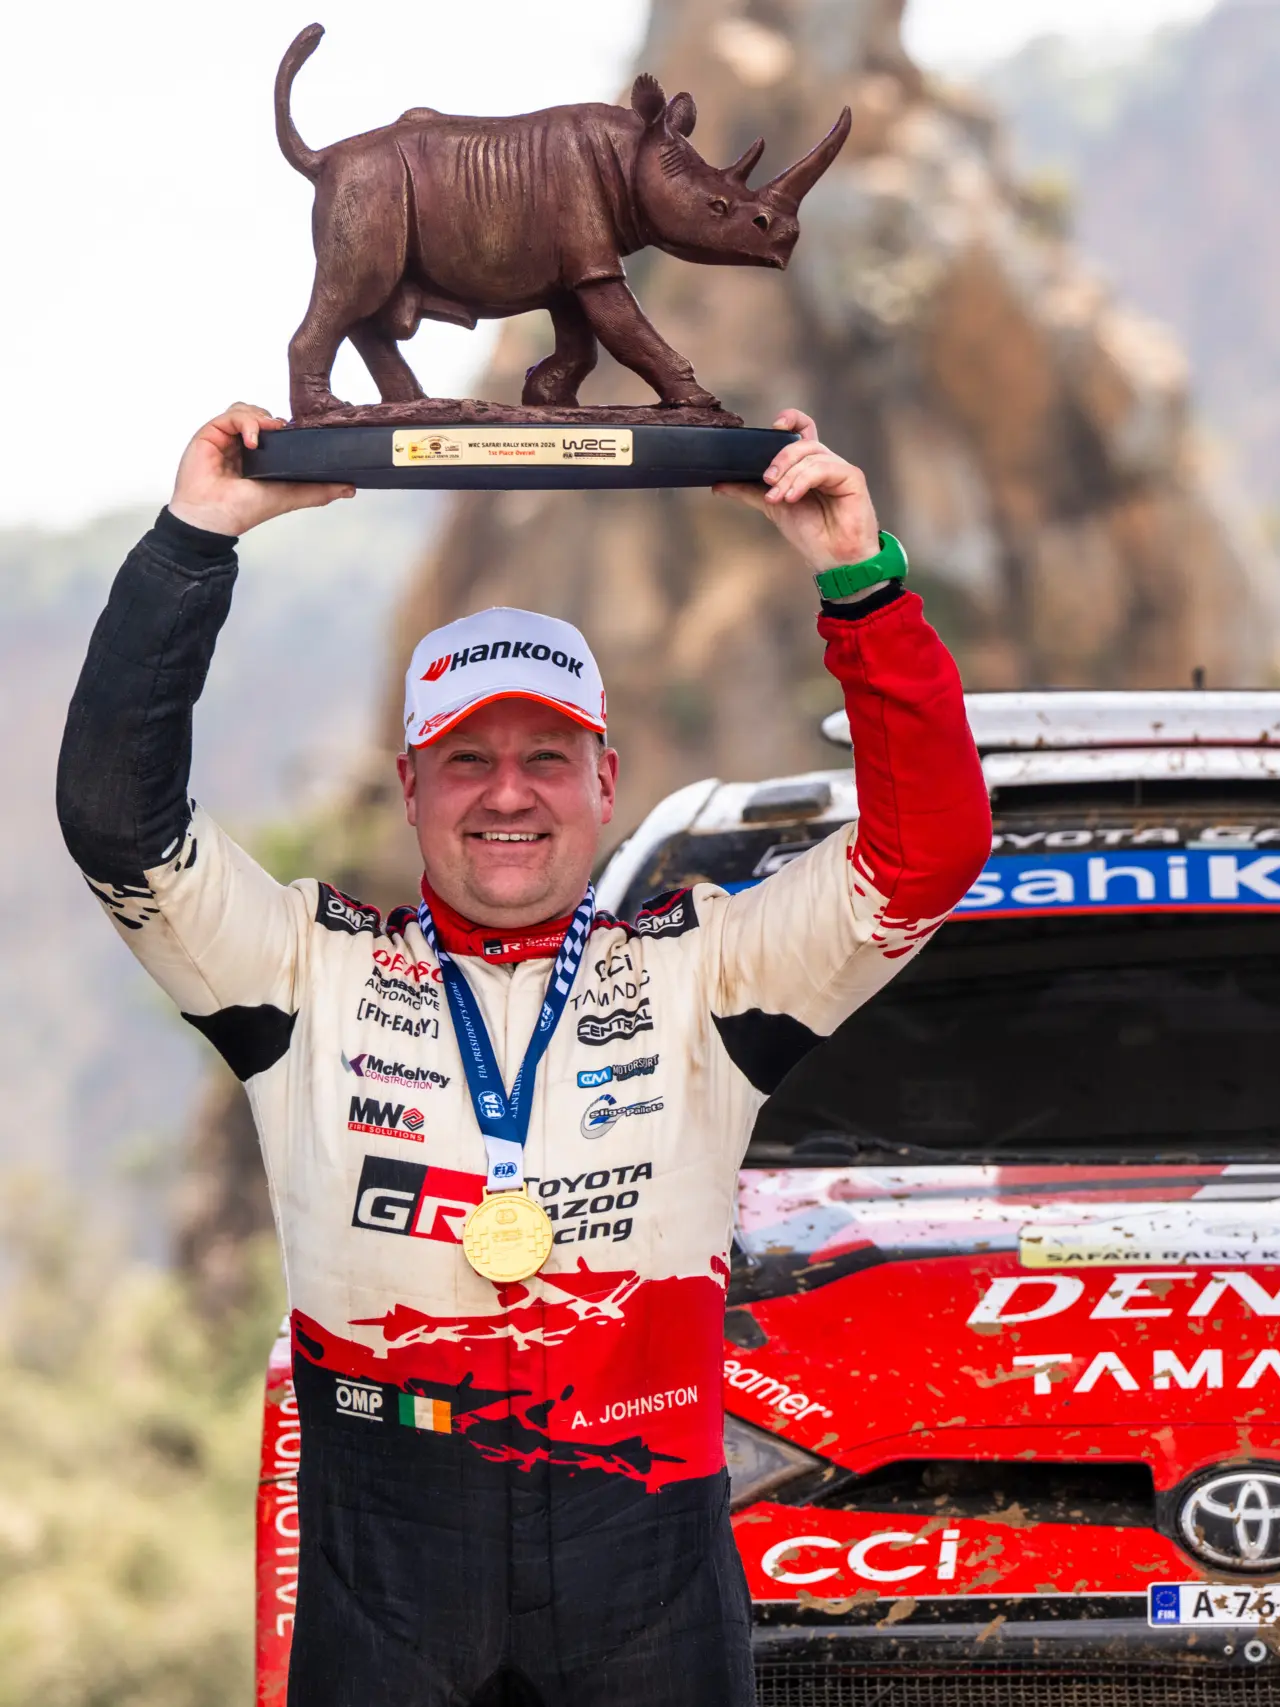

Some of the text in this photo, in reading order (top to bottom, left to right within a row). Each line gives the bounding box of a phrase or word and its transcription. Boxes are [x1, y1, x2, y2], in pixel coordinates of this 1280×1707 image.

[563, 438, 616, 450] WRC
[993, 828, 1179, 849] YOTA
[485, 943, 521, 956] GR
[577, 1008, 653, 1038] CENTRAL
[364, 1069, 433, 1090] CONSTRUCTION
[367, 1055, 451, 1089] McKelvey
[478, 1064, 488, 1079] FIA
[348, 1095, 405, 1129] MW
[349, 1123, 423, 1142] FIRE SOLUTIONS
[356, 1186, 480, 1243] GR
[1046, 1251, 1151, 1262] SAFARI
[1171, 1250, 1251, 1261] RALLY
[336, 1385, 383, 1415] OMP
[571, 1385, 699, 1430] A. JOHNSTON
[1157, 1610, 1176, 1620] FIN
